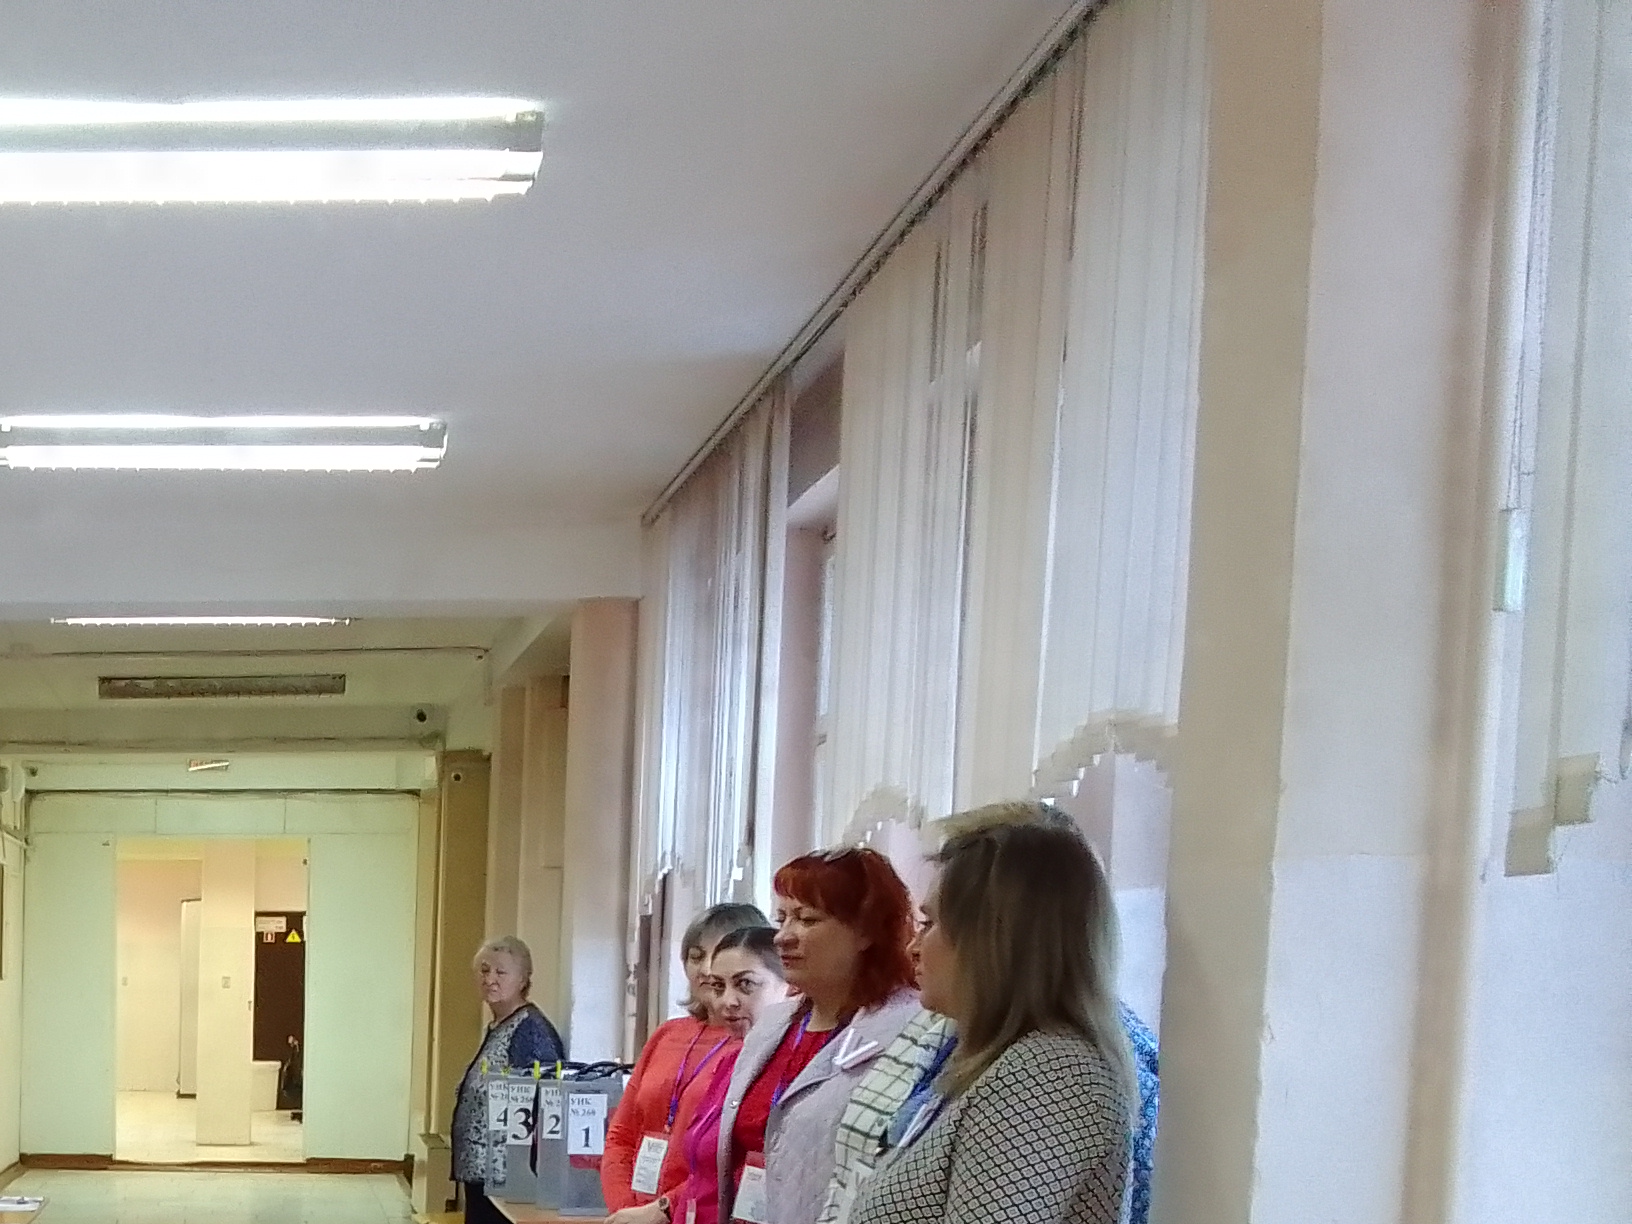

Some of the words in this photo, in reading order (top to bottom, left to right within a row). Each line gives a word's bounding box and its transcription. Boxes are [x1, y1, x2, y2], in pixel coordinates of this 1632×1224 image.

[496, 1107, 508, 1128] 4
[512, 1107, 534, 1141] 3
[547, 1114, 560, 1135] 2
[582, 1126, 591, 1149] 1
